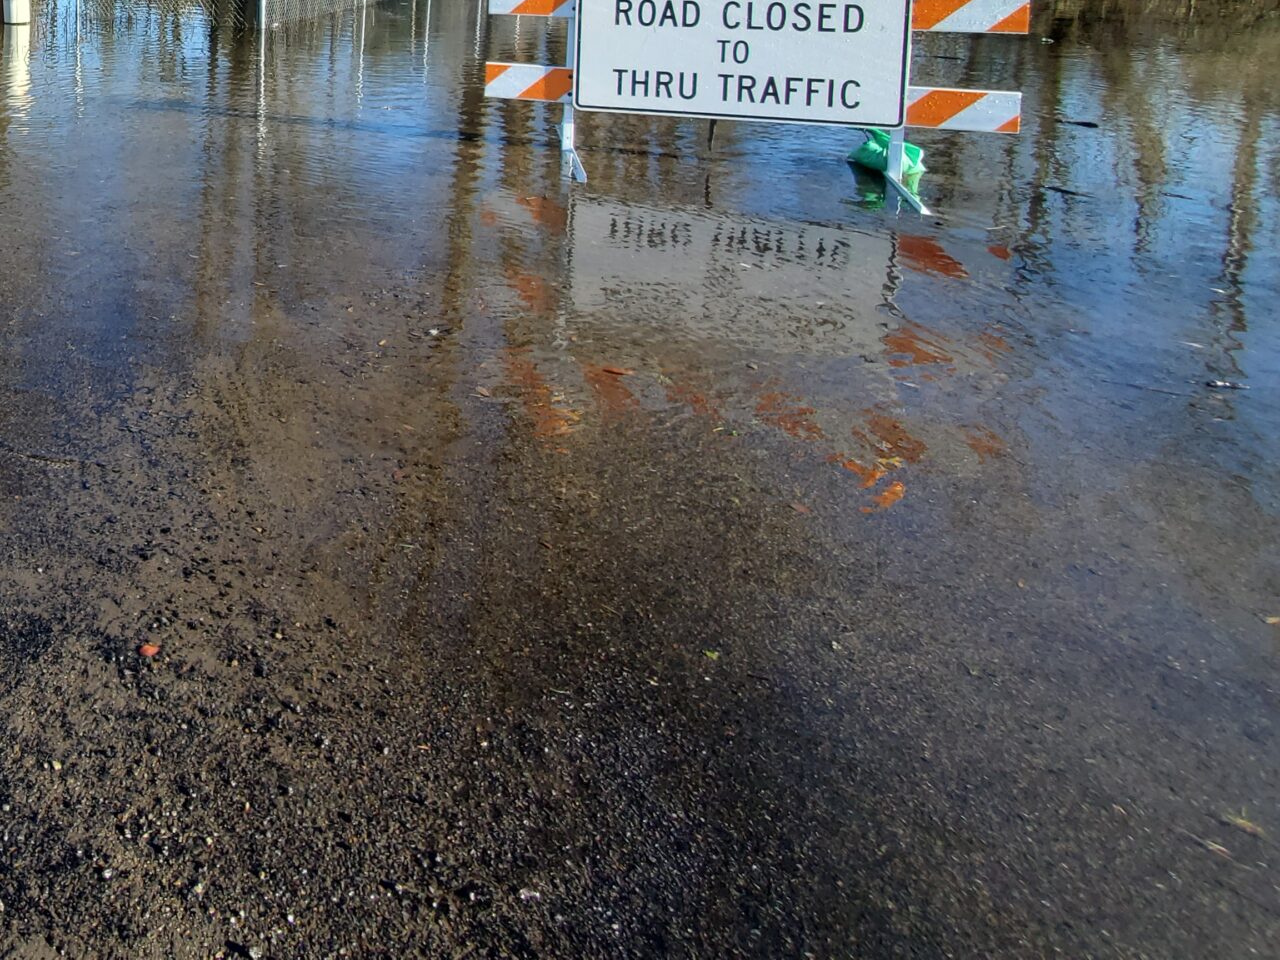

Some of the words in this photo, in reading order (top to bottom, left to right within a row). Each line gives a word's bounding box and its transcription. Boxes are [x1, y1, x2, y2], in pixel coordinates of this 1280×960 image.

[722, 0, 866, 34] CLOSED
[717, 38, 750, 64] TO
[612, 67, 699, 101] THRU
[717, 72, 862, 111] TRAFFIC
